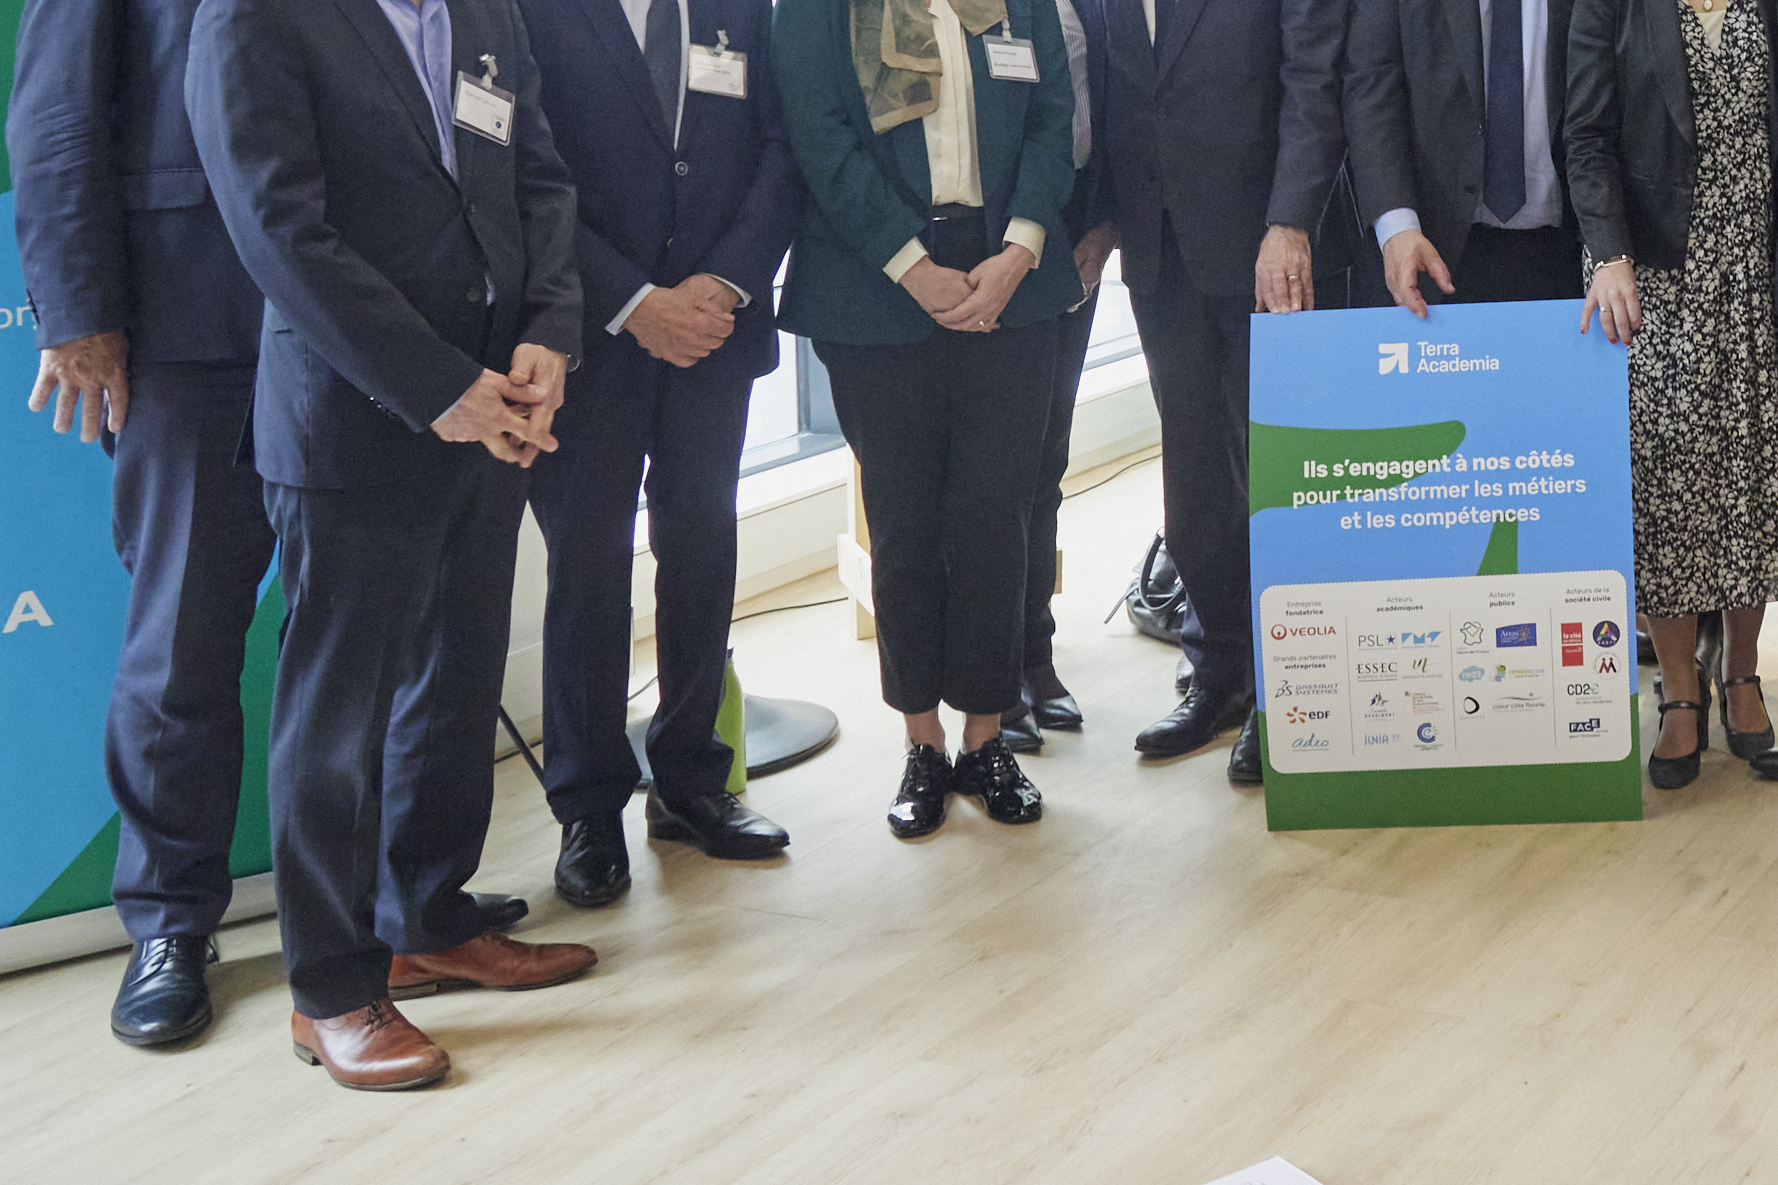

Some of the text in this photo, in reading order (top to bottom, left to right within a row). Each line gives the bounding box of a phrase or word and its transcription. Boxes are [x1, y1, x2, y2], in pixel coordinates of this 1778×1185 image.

[1417, 341, 1459, 357] Terra
[1417, 355, 1500, 374] Academia
[1303, 449, 1575, 480] Ils s'engagent à nos côtés
[1293, 476, 1586, 509] pour transformer les métiers
[1340, 506, 1541, 529] et les compétences
[1286, 600, 1321, 609] Entreprise
[1489, 600, 1515, 608] publics
[1565, 595, 1591, 603] société
[3, 590, 53, 633] A
[1376, 604, 1423, 612] académiques
[1289, 626, 1336, 637] VEOLIA
[1358, 634, 1383, 647] PSL
[1298, 654, 1337, 663] partenaires
[1284, 663, 1326, 671] entreprises
[1356, 662, 1398, 674] ESSEC
